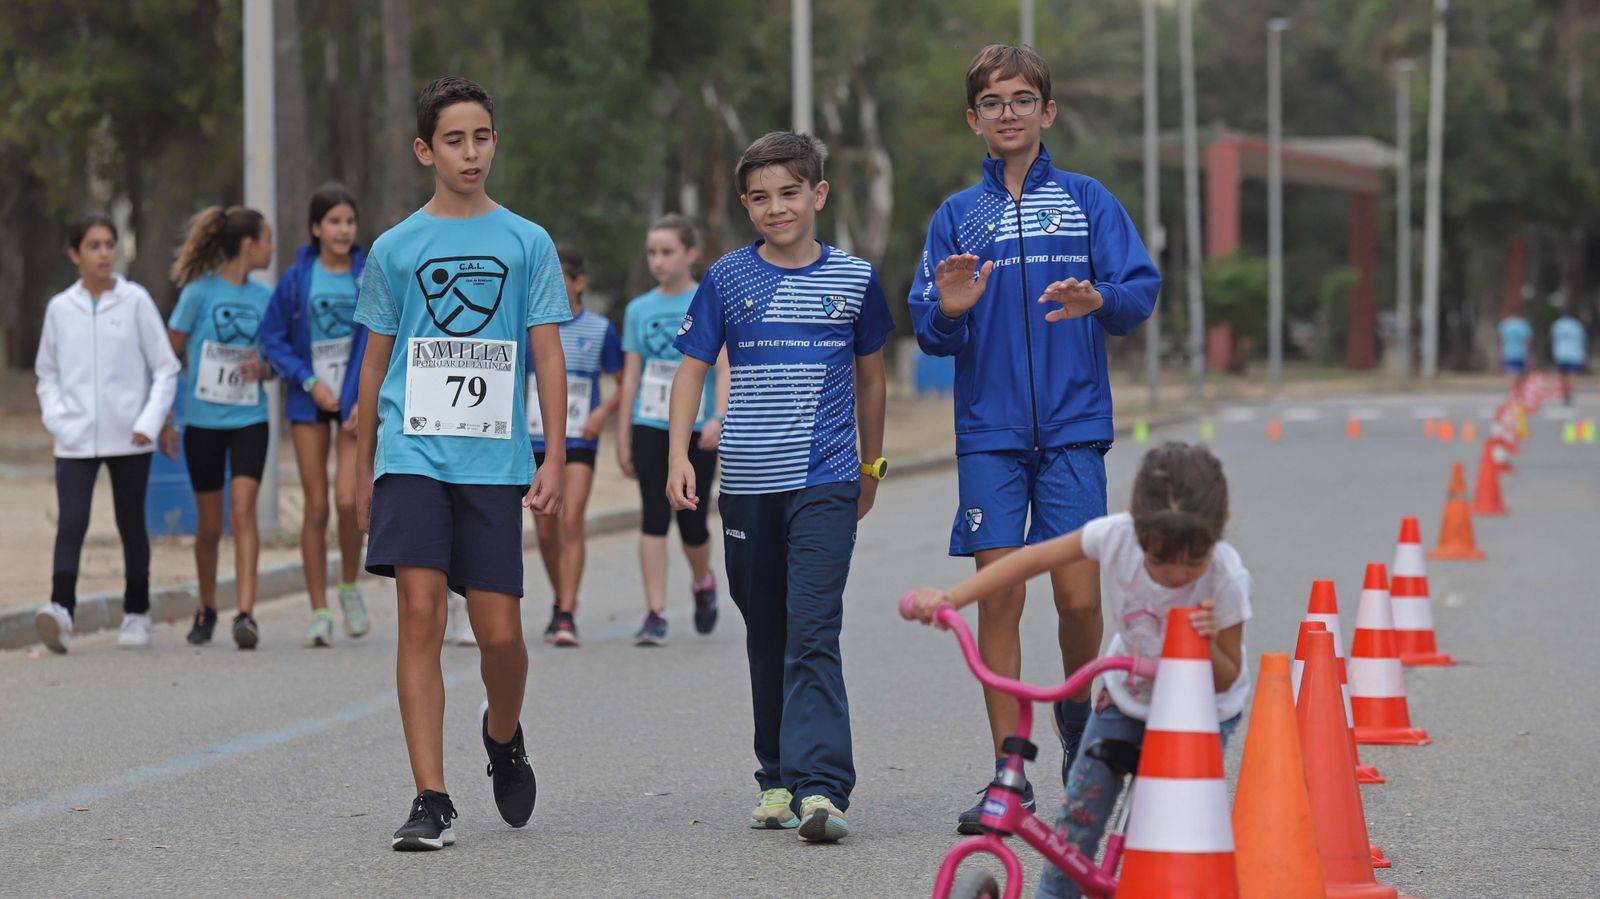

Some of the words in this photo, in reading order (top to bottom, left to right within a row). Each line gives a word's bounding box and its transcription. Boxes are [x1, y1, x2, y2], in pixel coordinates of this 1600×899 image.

[1052, 255, 1088, 263] LINENSE
[459, 262, 484, 270] C.A.L.
[738, 340, 755, 348] CLUB
[757, 339, 810, 347] ATLETISMO
[416, 342, 421, 359] I
[432, 341, 509, 362] MILLA
[446, 375, 487, 408] 79
